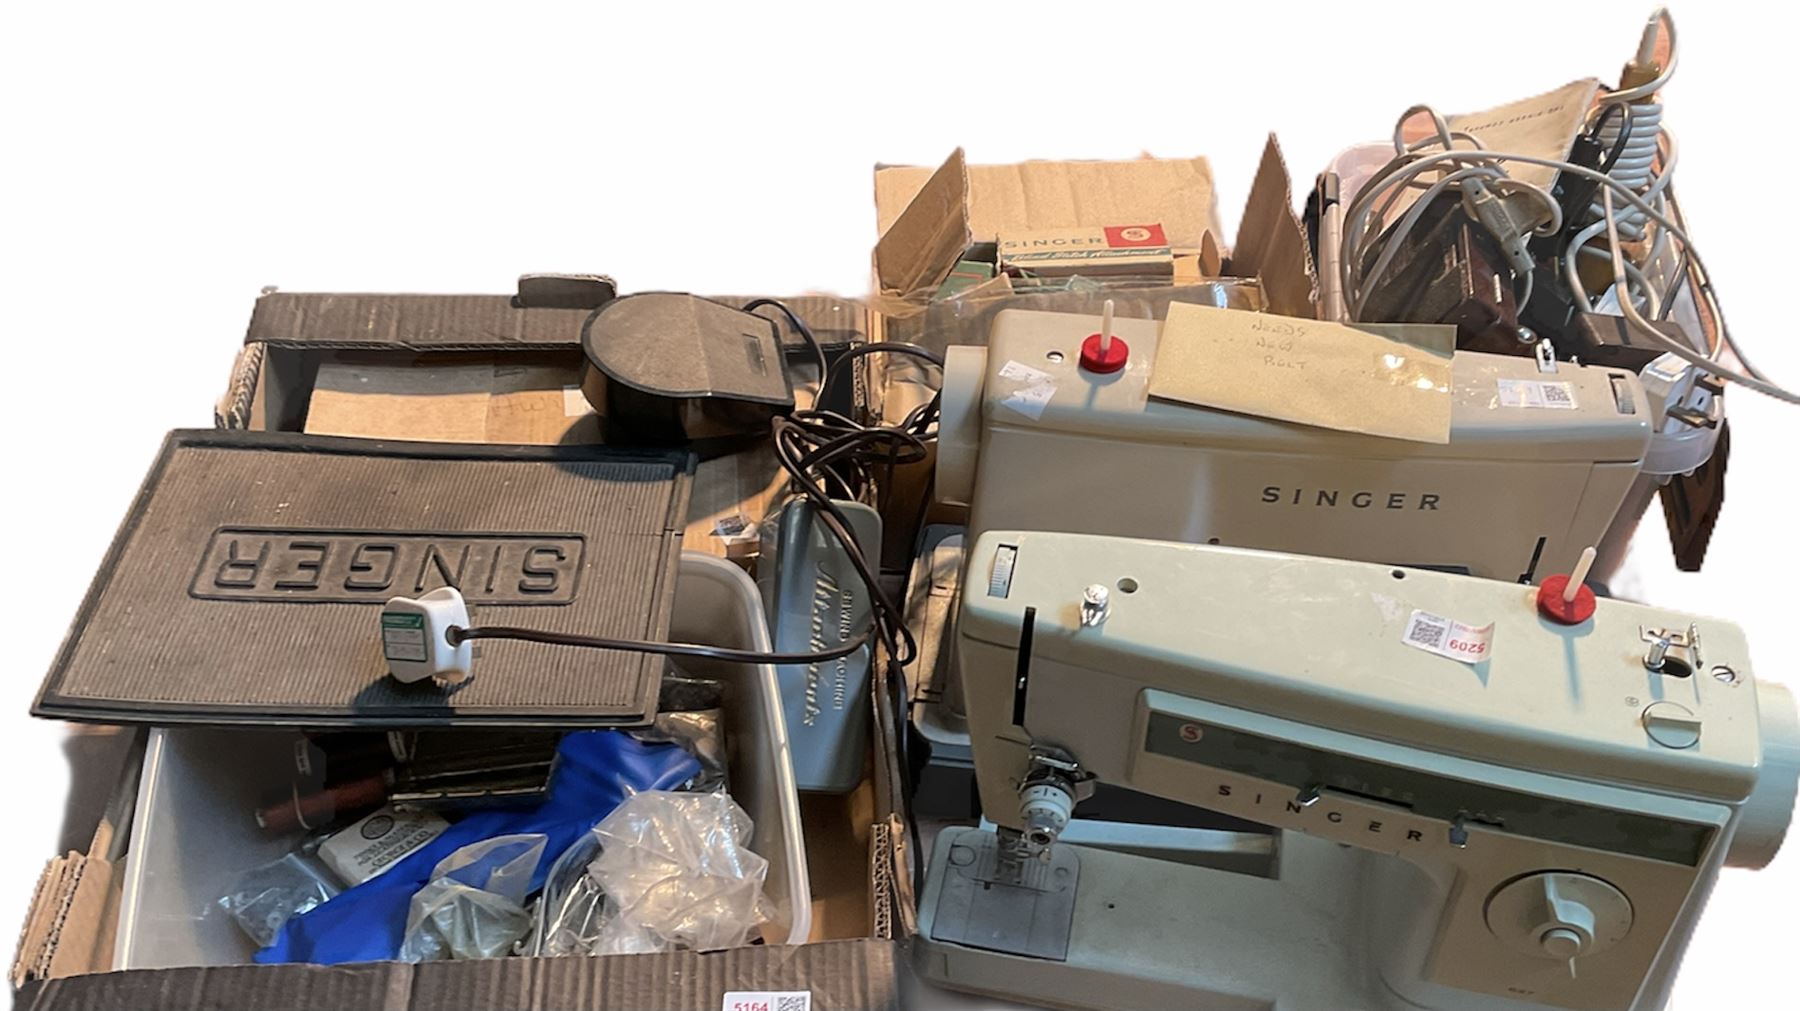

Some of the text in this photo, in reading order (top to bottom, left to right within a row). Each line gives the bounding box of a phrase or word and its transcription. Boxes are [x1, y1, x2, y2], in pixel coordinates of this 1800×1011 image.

[1004, 237, 1103, 248] SINGER
[1256, 336, 1293, 352] NEW
[1261, 485, 1441, 511] SINGER
[213, 538, 567, 595] SINGER
[1449, 638, 1487, 654] 5209
[1217, 783, 1424, 842] SINGER
[734, 1002, 769, 1011] 5164
